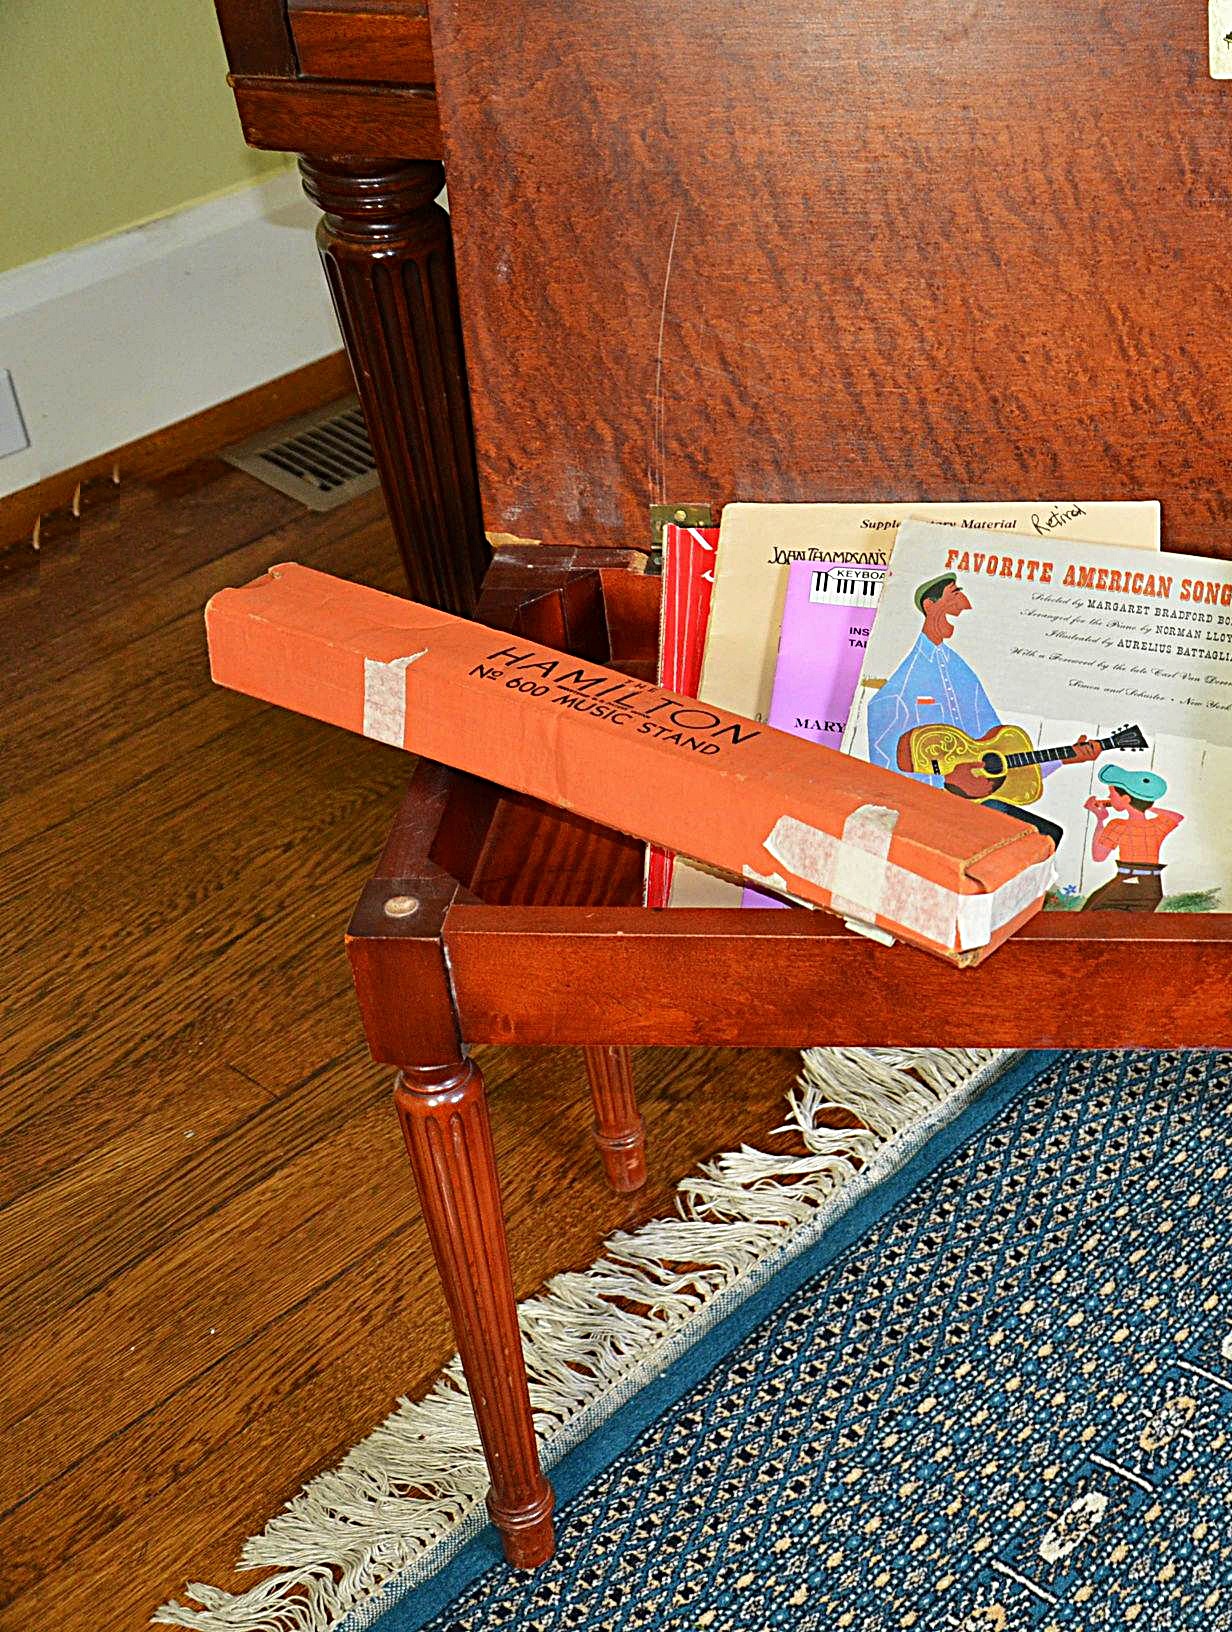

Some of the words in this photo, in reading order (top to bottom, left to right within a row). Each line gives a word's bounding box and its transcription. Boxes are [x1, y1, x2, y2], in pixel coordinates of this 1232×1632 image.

[961, 519, 1017, 529] Material
[768, 546, 806, 564] JOHN
[837, 569, 885, 580] KEYBOA
[944, 549, 1053, 583] FAVORITE
[1063, 565, 1173, 599] AMERICAN
[1032, 592, 1071, 604] Selected
[1072, 599, 1084, 608] by
[1087, 599, 1150, 615] MARGARET
[1154, 607, 1213, 624] BRADFORD
[850, 627, 870, 637] INS
[1019, 608, 1072, 622] Arranged
[1089, 618, 1102, 626] the
[1140, 624, 1152, 634] by
[1155, 625, 1202, 640] NORMAN
[1045, 630, 1100, 643] Illustrated
[1101, 638, 1114, 648] by
[1117, 639, 1172, 654] AURELIUS
[1097, 661, 1109, 670] by
[1113, 663, 1126, 671] the
[487, 646, 761, 745] HAMILTON
[506, 677, 550, 697] 600
[552, 694, 633, 725] MUSIC
[637, 722, 721, 755] STAND
[794, 717, 846, 733] MARY
